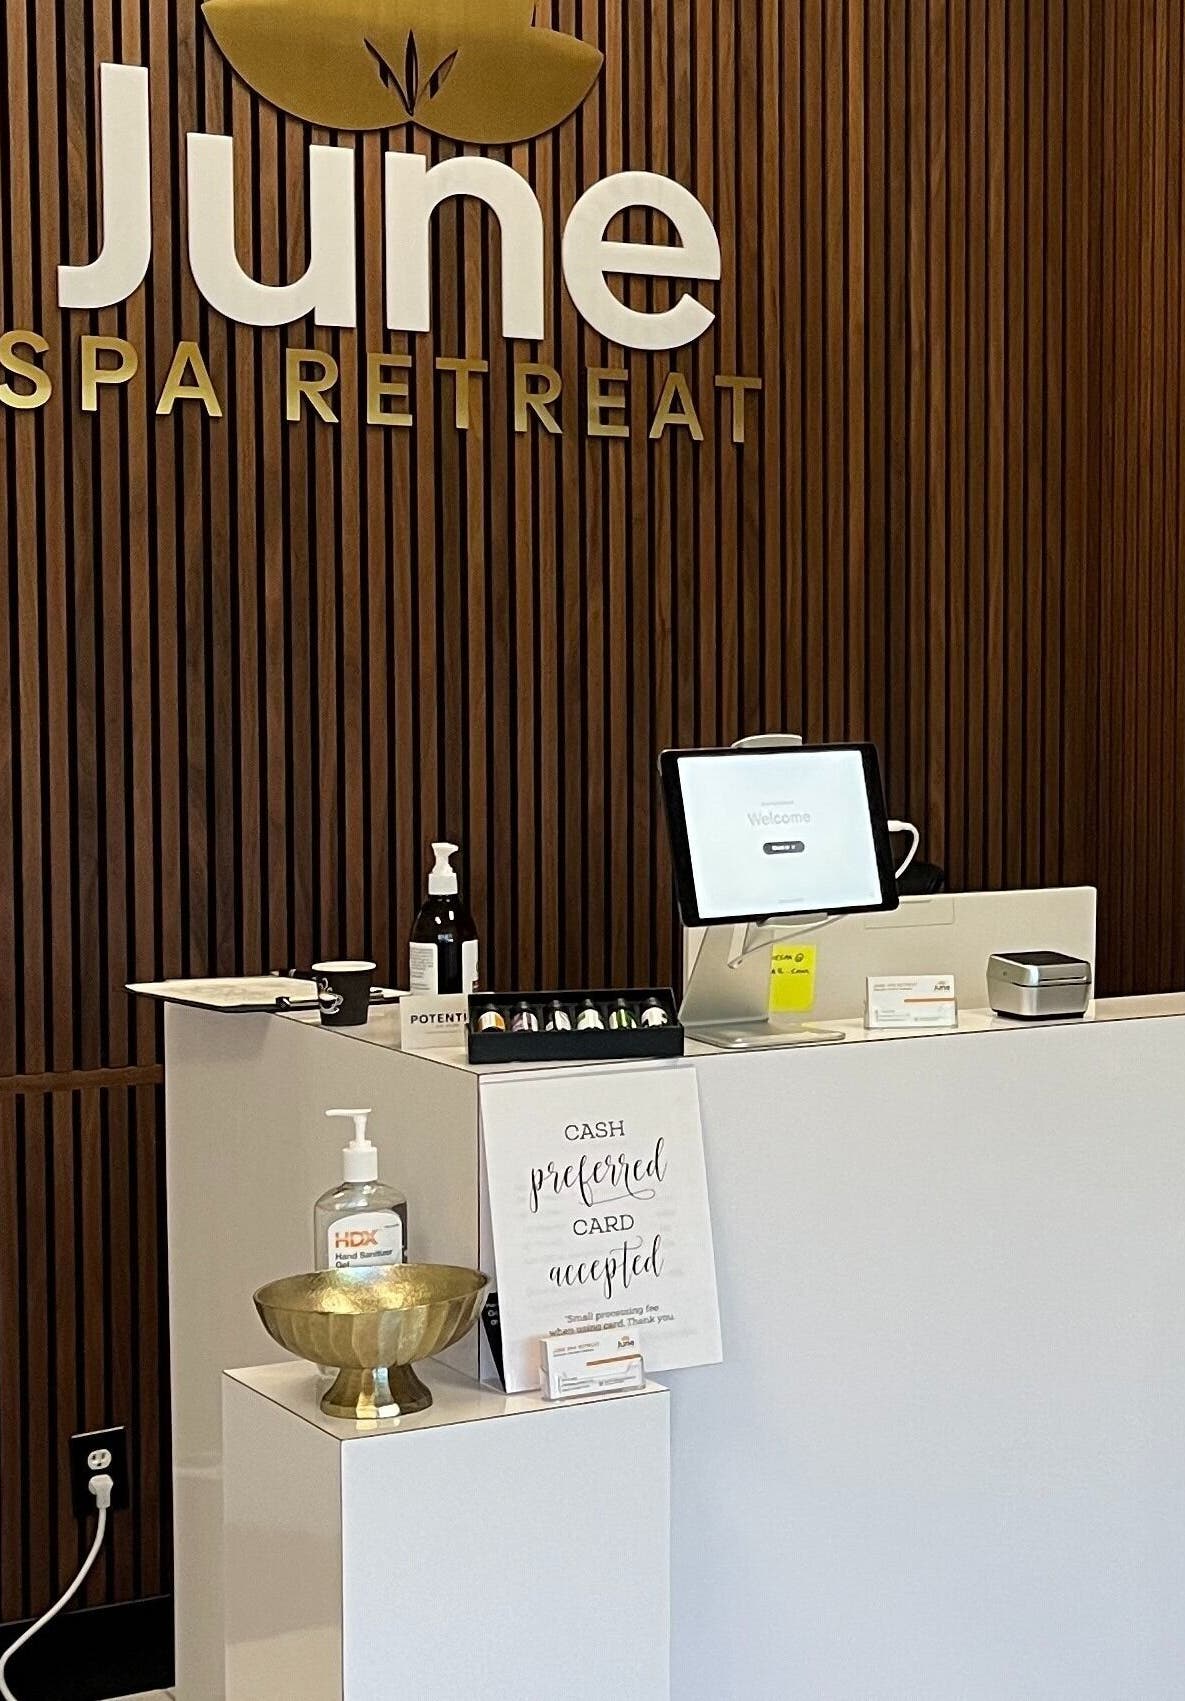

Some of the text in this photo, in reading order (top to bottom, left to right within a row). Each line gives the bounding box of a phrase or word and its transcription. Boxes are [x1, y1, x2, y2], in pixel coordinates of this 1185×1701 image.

[57, 61, 722, 351] June
[0, 329, 762, 444] SPA RETREAT
[747, 811, 811, 826] Welcome
[410, 1012, 467, 1024] POTENTI
[564, 1120, 625, 1141] CASH
[529, 1137, 668, 1213] preferred
[573, 1214, 635, 1236] CARD
[335, 1230, 378, 1248] HDX
[335, 1249, 393, 1261] Hand Sanitizer
[549, 1234, 665, 1299] accepted
[595, 1306, 644, 1321] processing
[645, 1304, 659, 1313] fee
[549, 1327, 574, 1337] when
[577, 1323, 602, 1334] using
[627, 1315, 655, 1326] Thank
[657, 1314, 674, 1325] you
